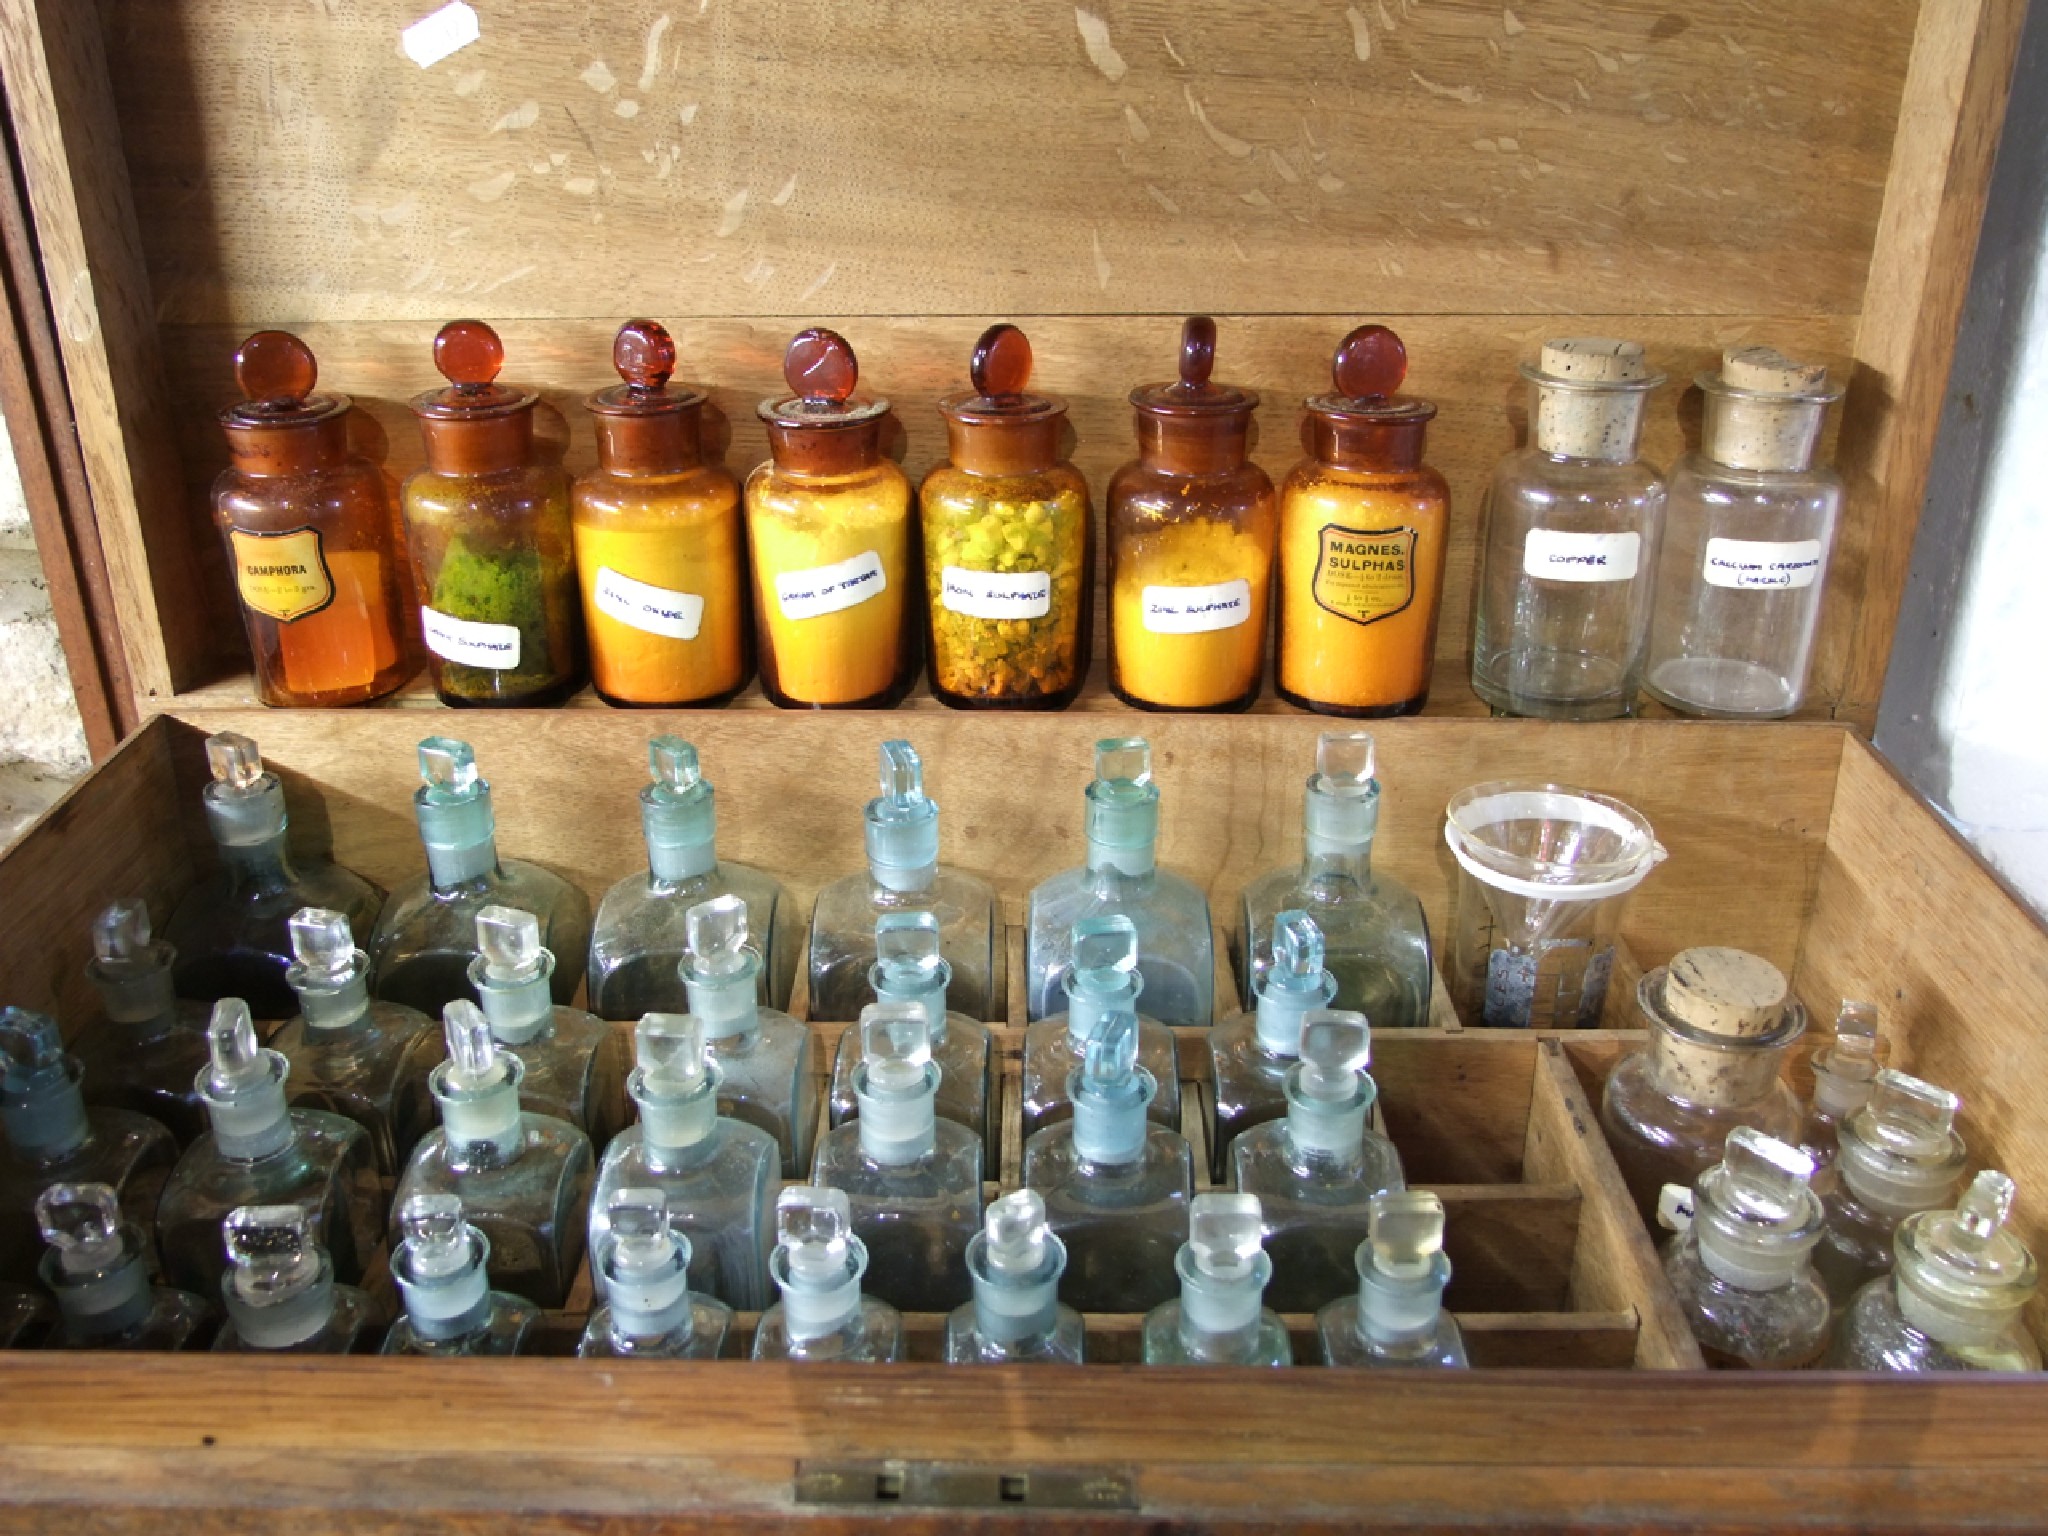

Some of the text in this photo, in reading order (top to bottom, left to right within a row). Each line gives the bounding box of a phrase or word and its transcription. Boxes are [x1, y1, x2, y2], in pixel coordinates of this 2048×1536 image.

[1330, 541, 1404, 556] MAGNES.
[1329, 557, 1405, 572] SULPHAS
[1549, 555, 1606, 566] COPPER
[246, 564, 308, 577] CAMPHORA
